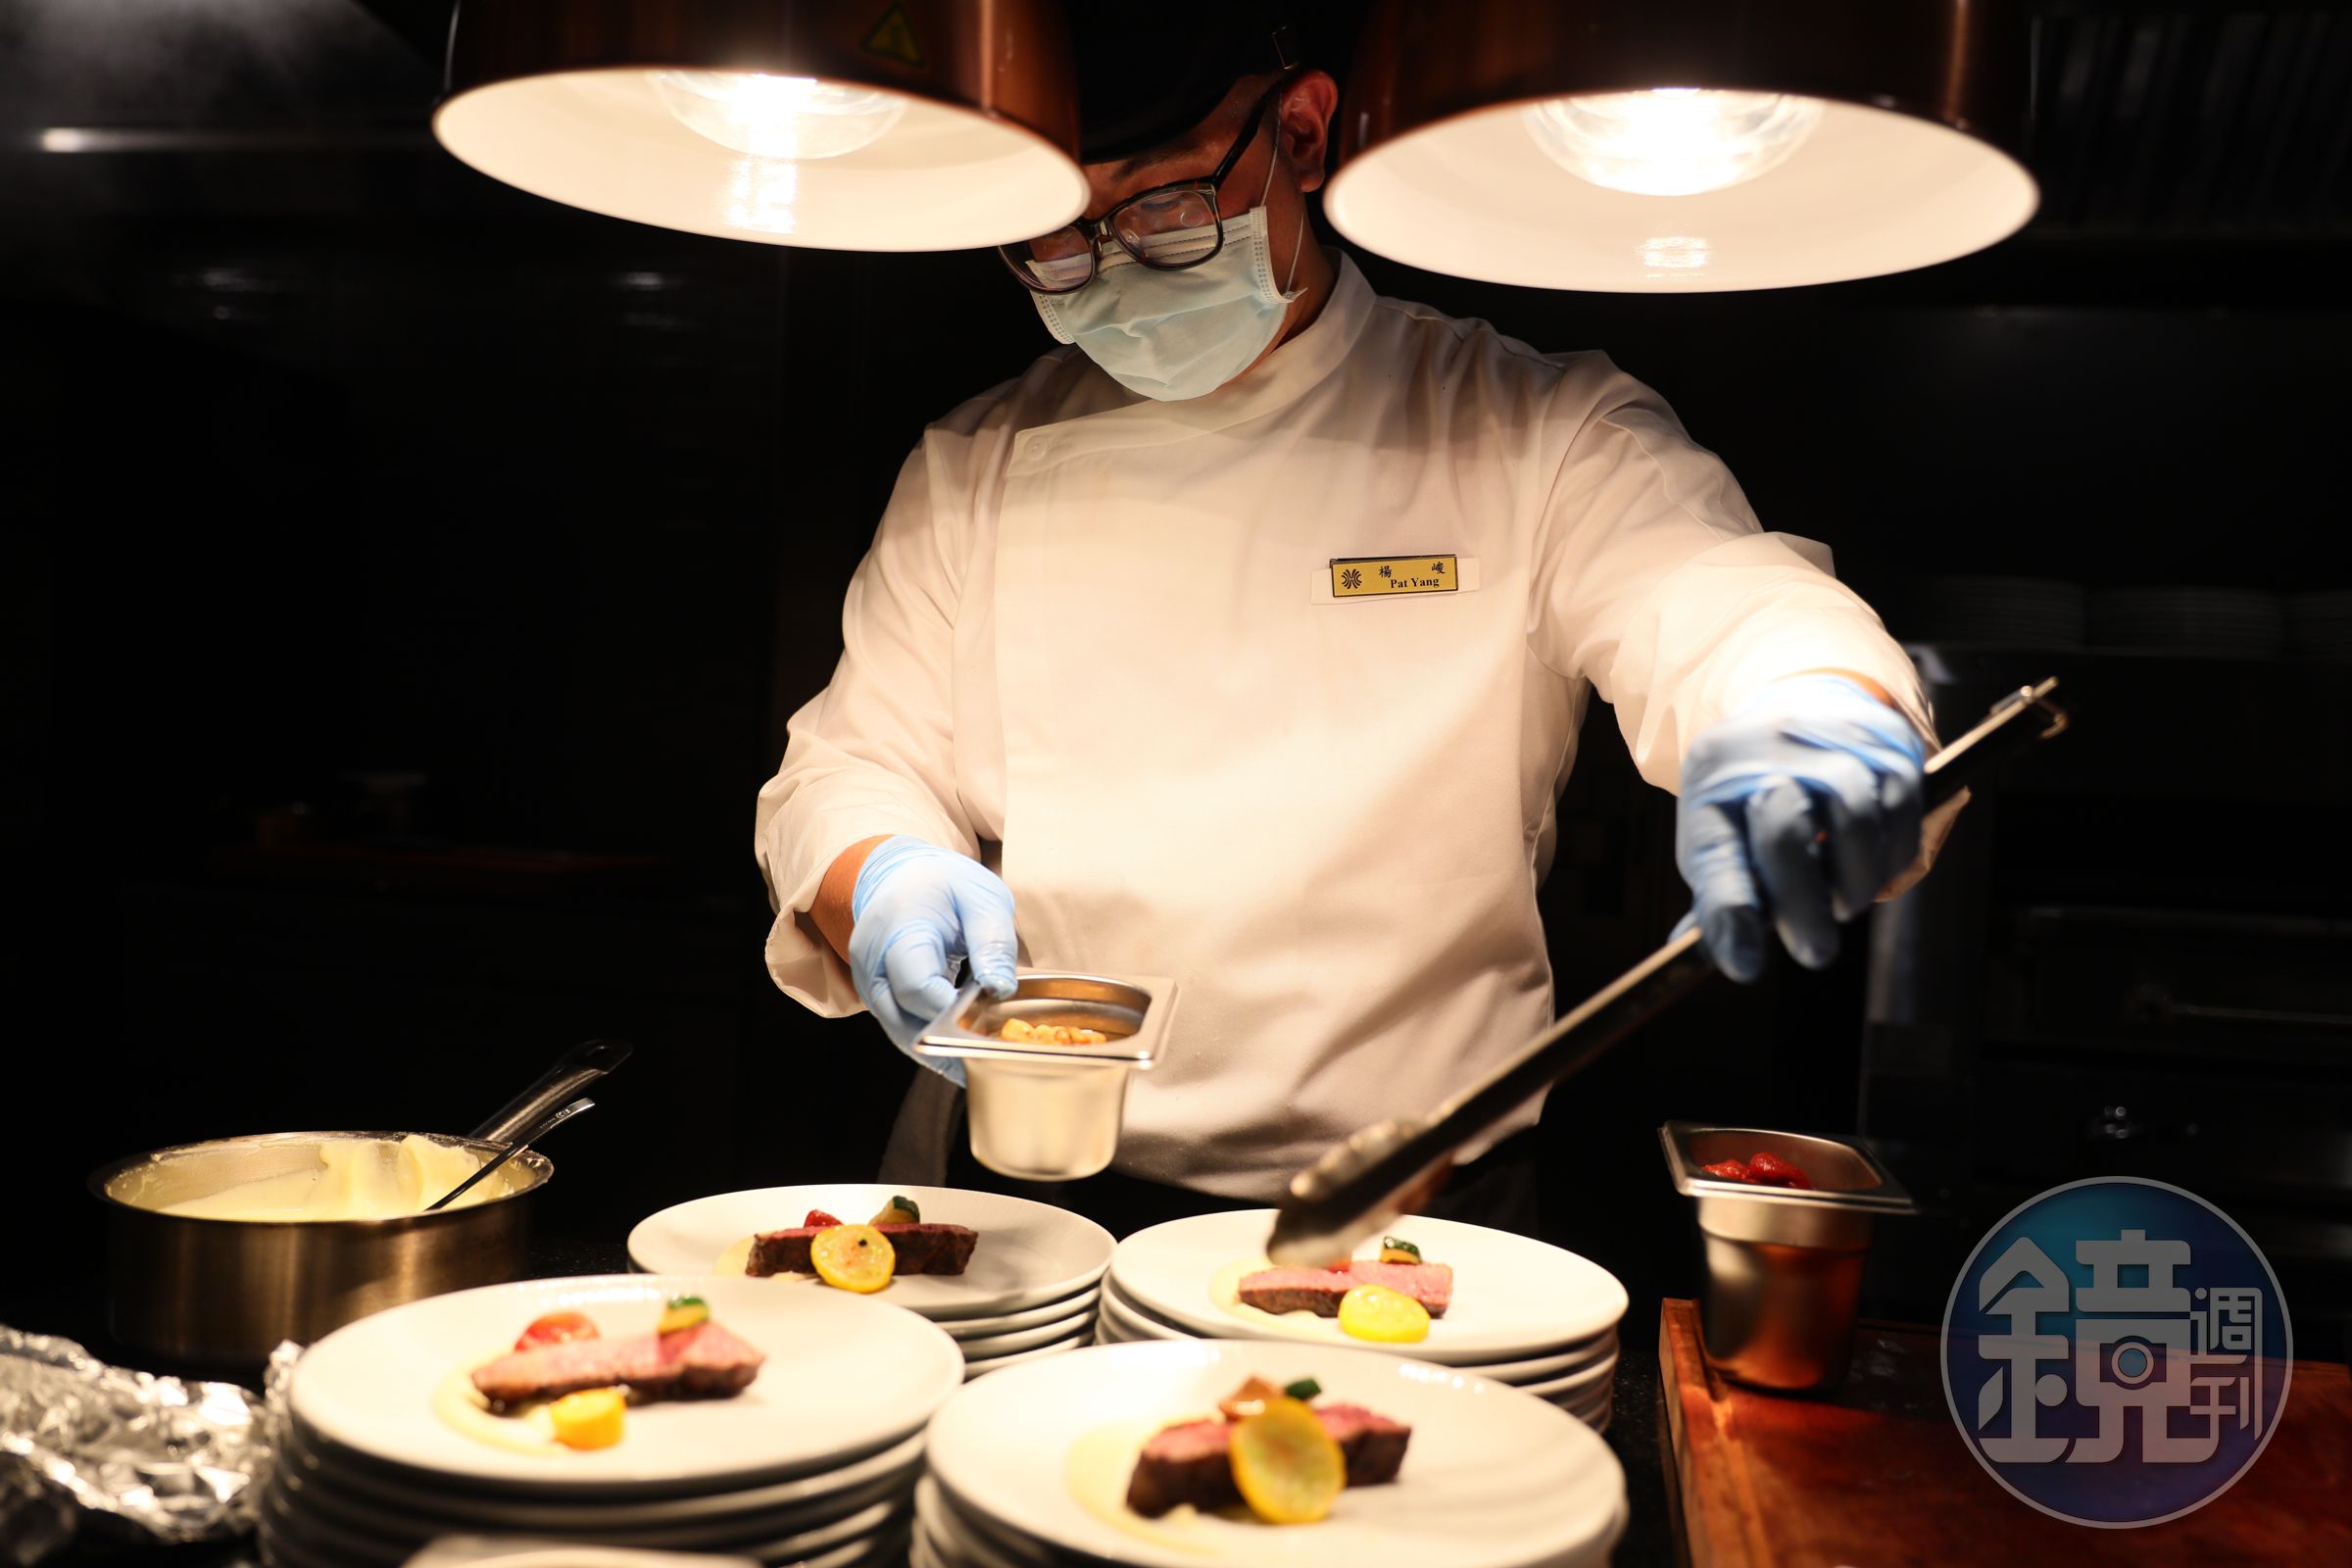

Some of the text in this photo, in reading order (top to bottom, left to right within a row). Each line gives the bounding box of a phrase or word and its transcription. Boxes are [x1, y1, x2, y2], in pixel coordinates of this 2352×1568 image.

[1379, 565, 1392, 577] 楊
[1391, 578, 1440, 588] Pat Yang
